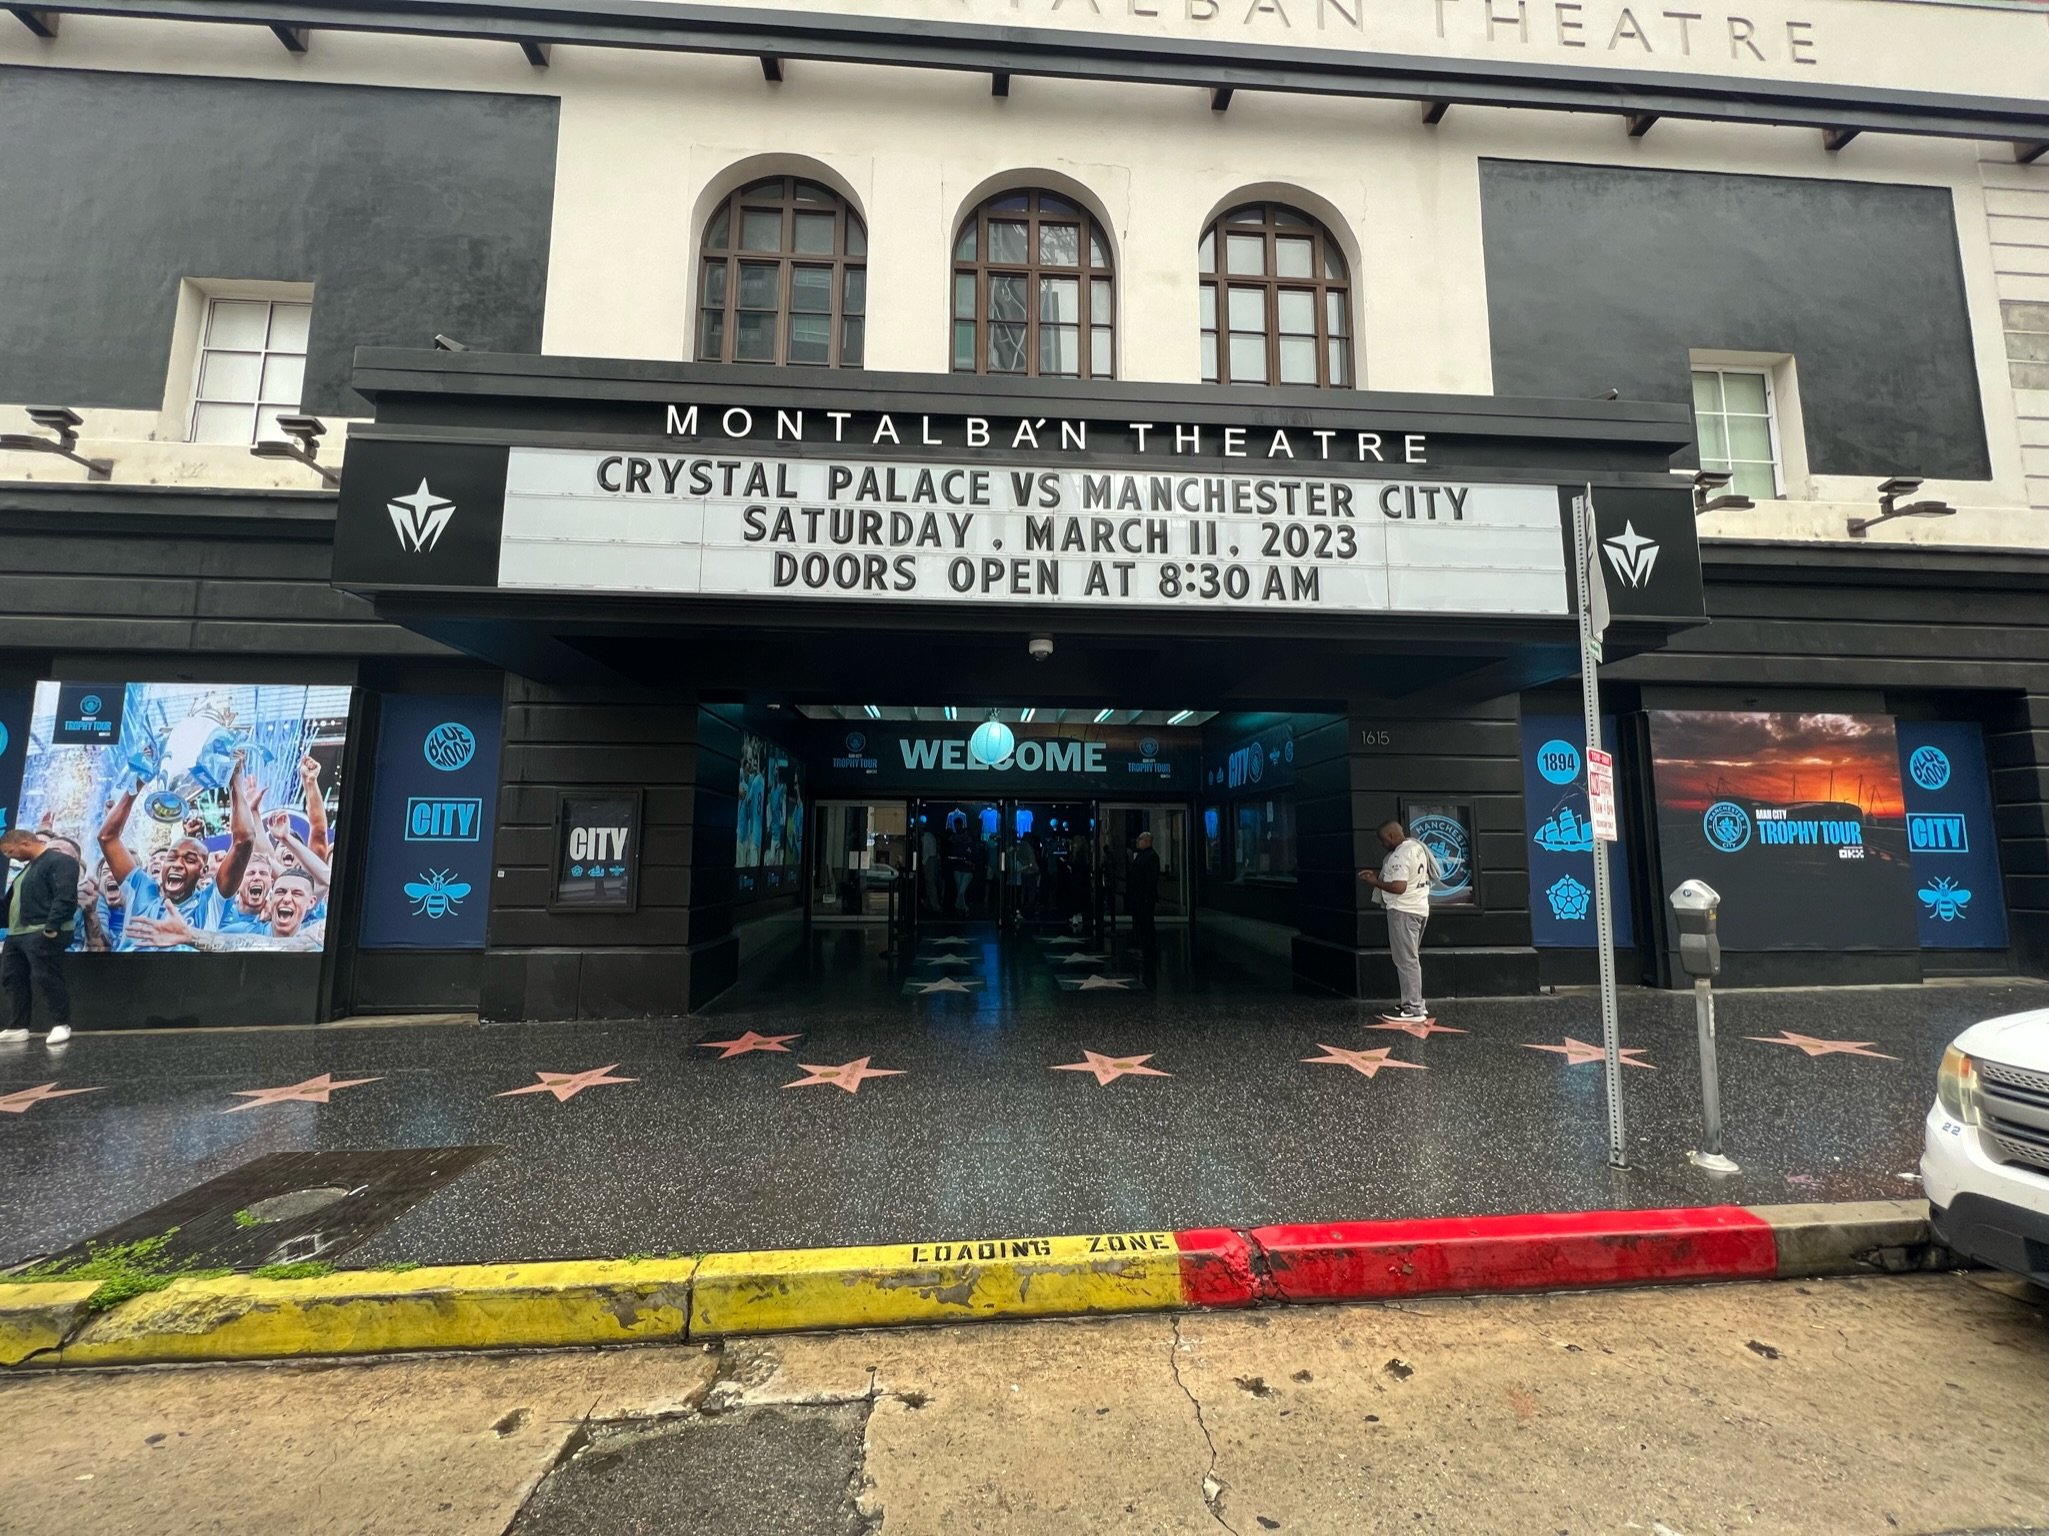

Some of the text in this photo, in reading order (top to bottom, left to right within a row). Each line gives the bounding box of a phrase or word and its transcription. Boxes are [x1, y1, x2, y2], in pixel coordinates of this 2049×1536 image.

[1434, 0, 1818, 65] THEATRE
[1130, 424, 1427, 463] THEATRE
[597, 457, 1469, 520] CRYSTAL PALACE VS MANCHESTER CITY
[1026, 515, 1168, 555] MARCH
[1262, 522, 1358, 559] 2023
[774, 551, 1320, 602] DOORS OPEN AT 8:30 AM
[93, 720, 112, 731] TOUR
[1361, 730, 1390, 745] 1615
[428, 726, 471, 761] BLUE
[436, 741, 472, 768] MOON
[832, 757, 878, 769] TROPHY TOUR
[1128, 762, 1171, 773] TROPHY TOUR
[1228, 746, 1250, 789] CITY
[1542, 752, 1576, 772] 1894
[1913, 750, 1946, 778] BLUE
[1921, 762, 1947, 786] MOON
[412, 803, 475, 836] CITY
[1709, 806, 1745, 821] MANCHESTER
[1772, 809, 1787, 820] CITY
[569, 826, 629, 861] CITY
[1416, 821, 1469, 860] MANCHESTER
[1757, 820, 1863, 845] TROPHY TOUR
[1911, 817, 1960, 848] CITY
[1838, 849, 1865, 859] OKX
[1942, 1122, 1961, 1135] 22
[912, 1234, 1170, 1263] LOADING ZONE
